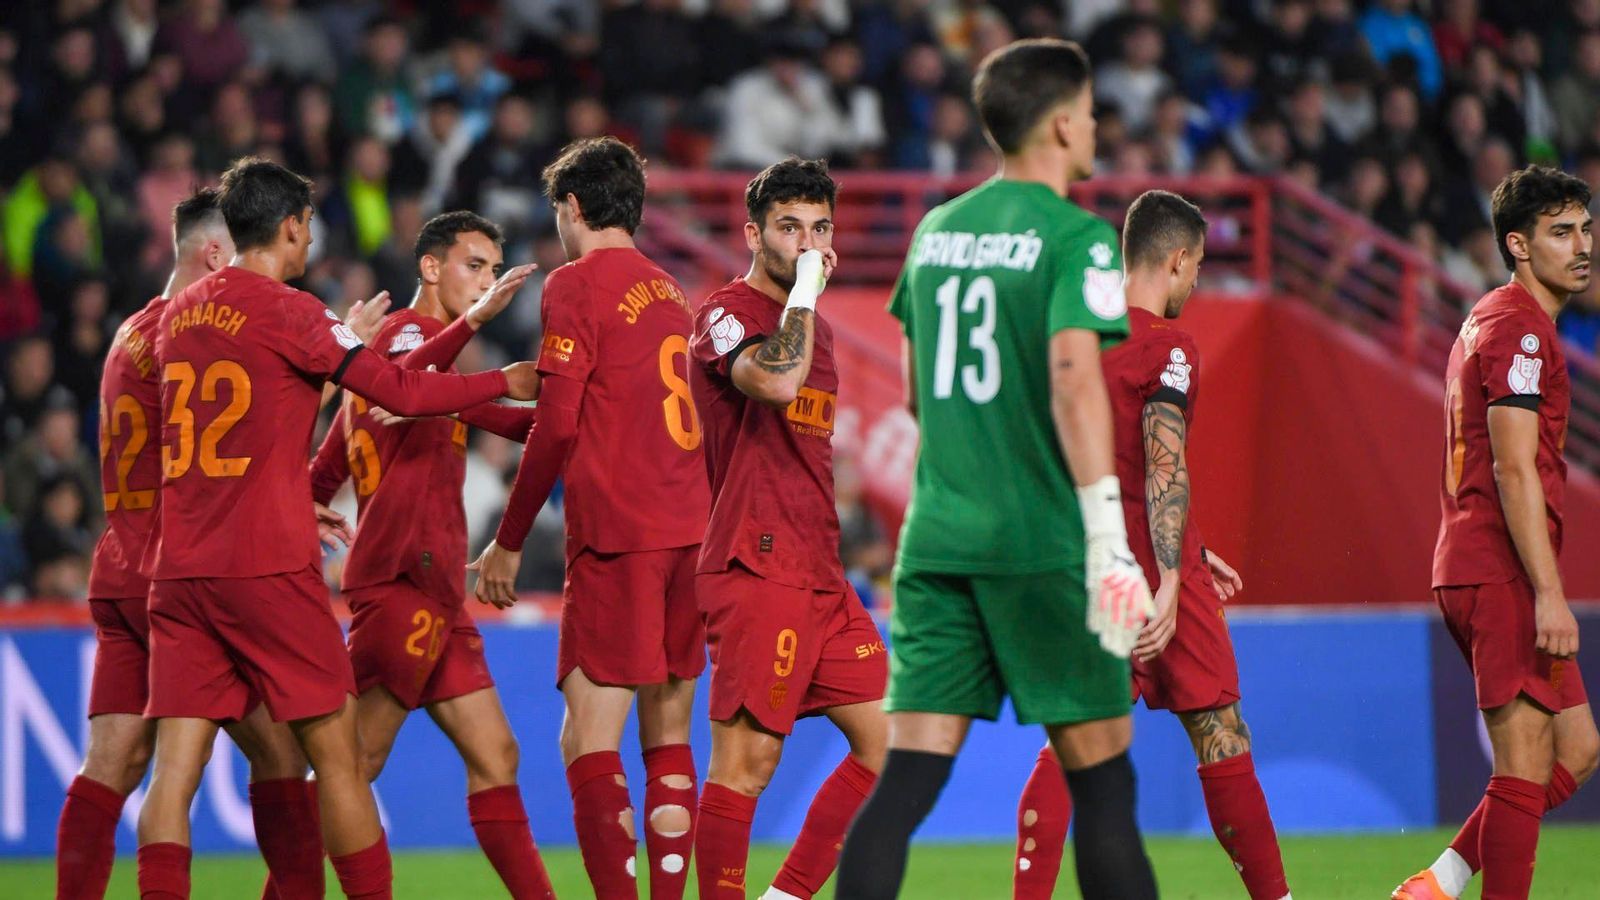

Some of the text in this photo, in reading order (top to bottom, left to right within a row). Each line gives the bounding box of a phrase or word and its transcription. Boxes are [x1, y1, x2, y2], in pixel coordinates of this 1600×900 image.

[169, 302, 247, 338] PANACH
[617, 281, 654, 325] JAVI
[933, 275, 1001, 404] 13
[161, 359, 252, 478] 32
[659, 334, 701, 451] 8
[774, 628, 798, 677] 9
